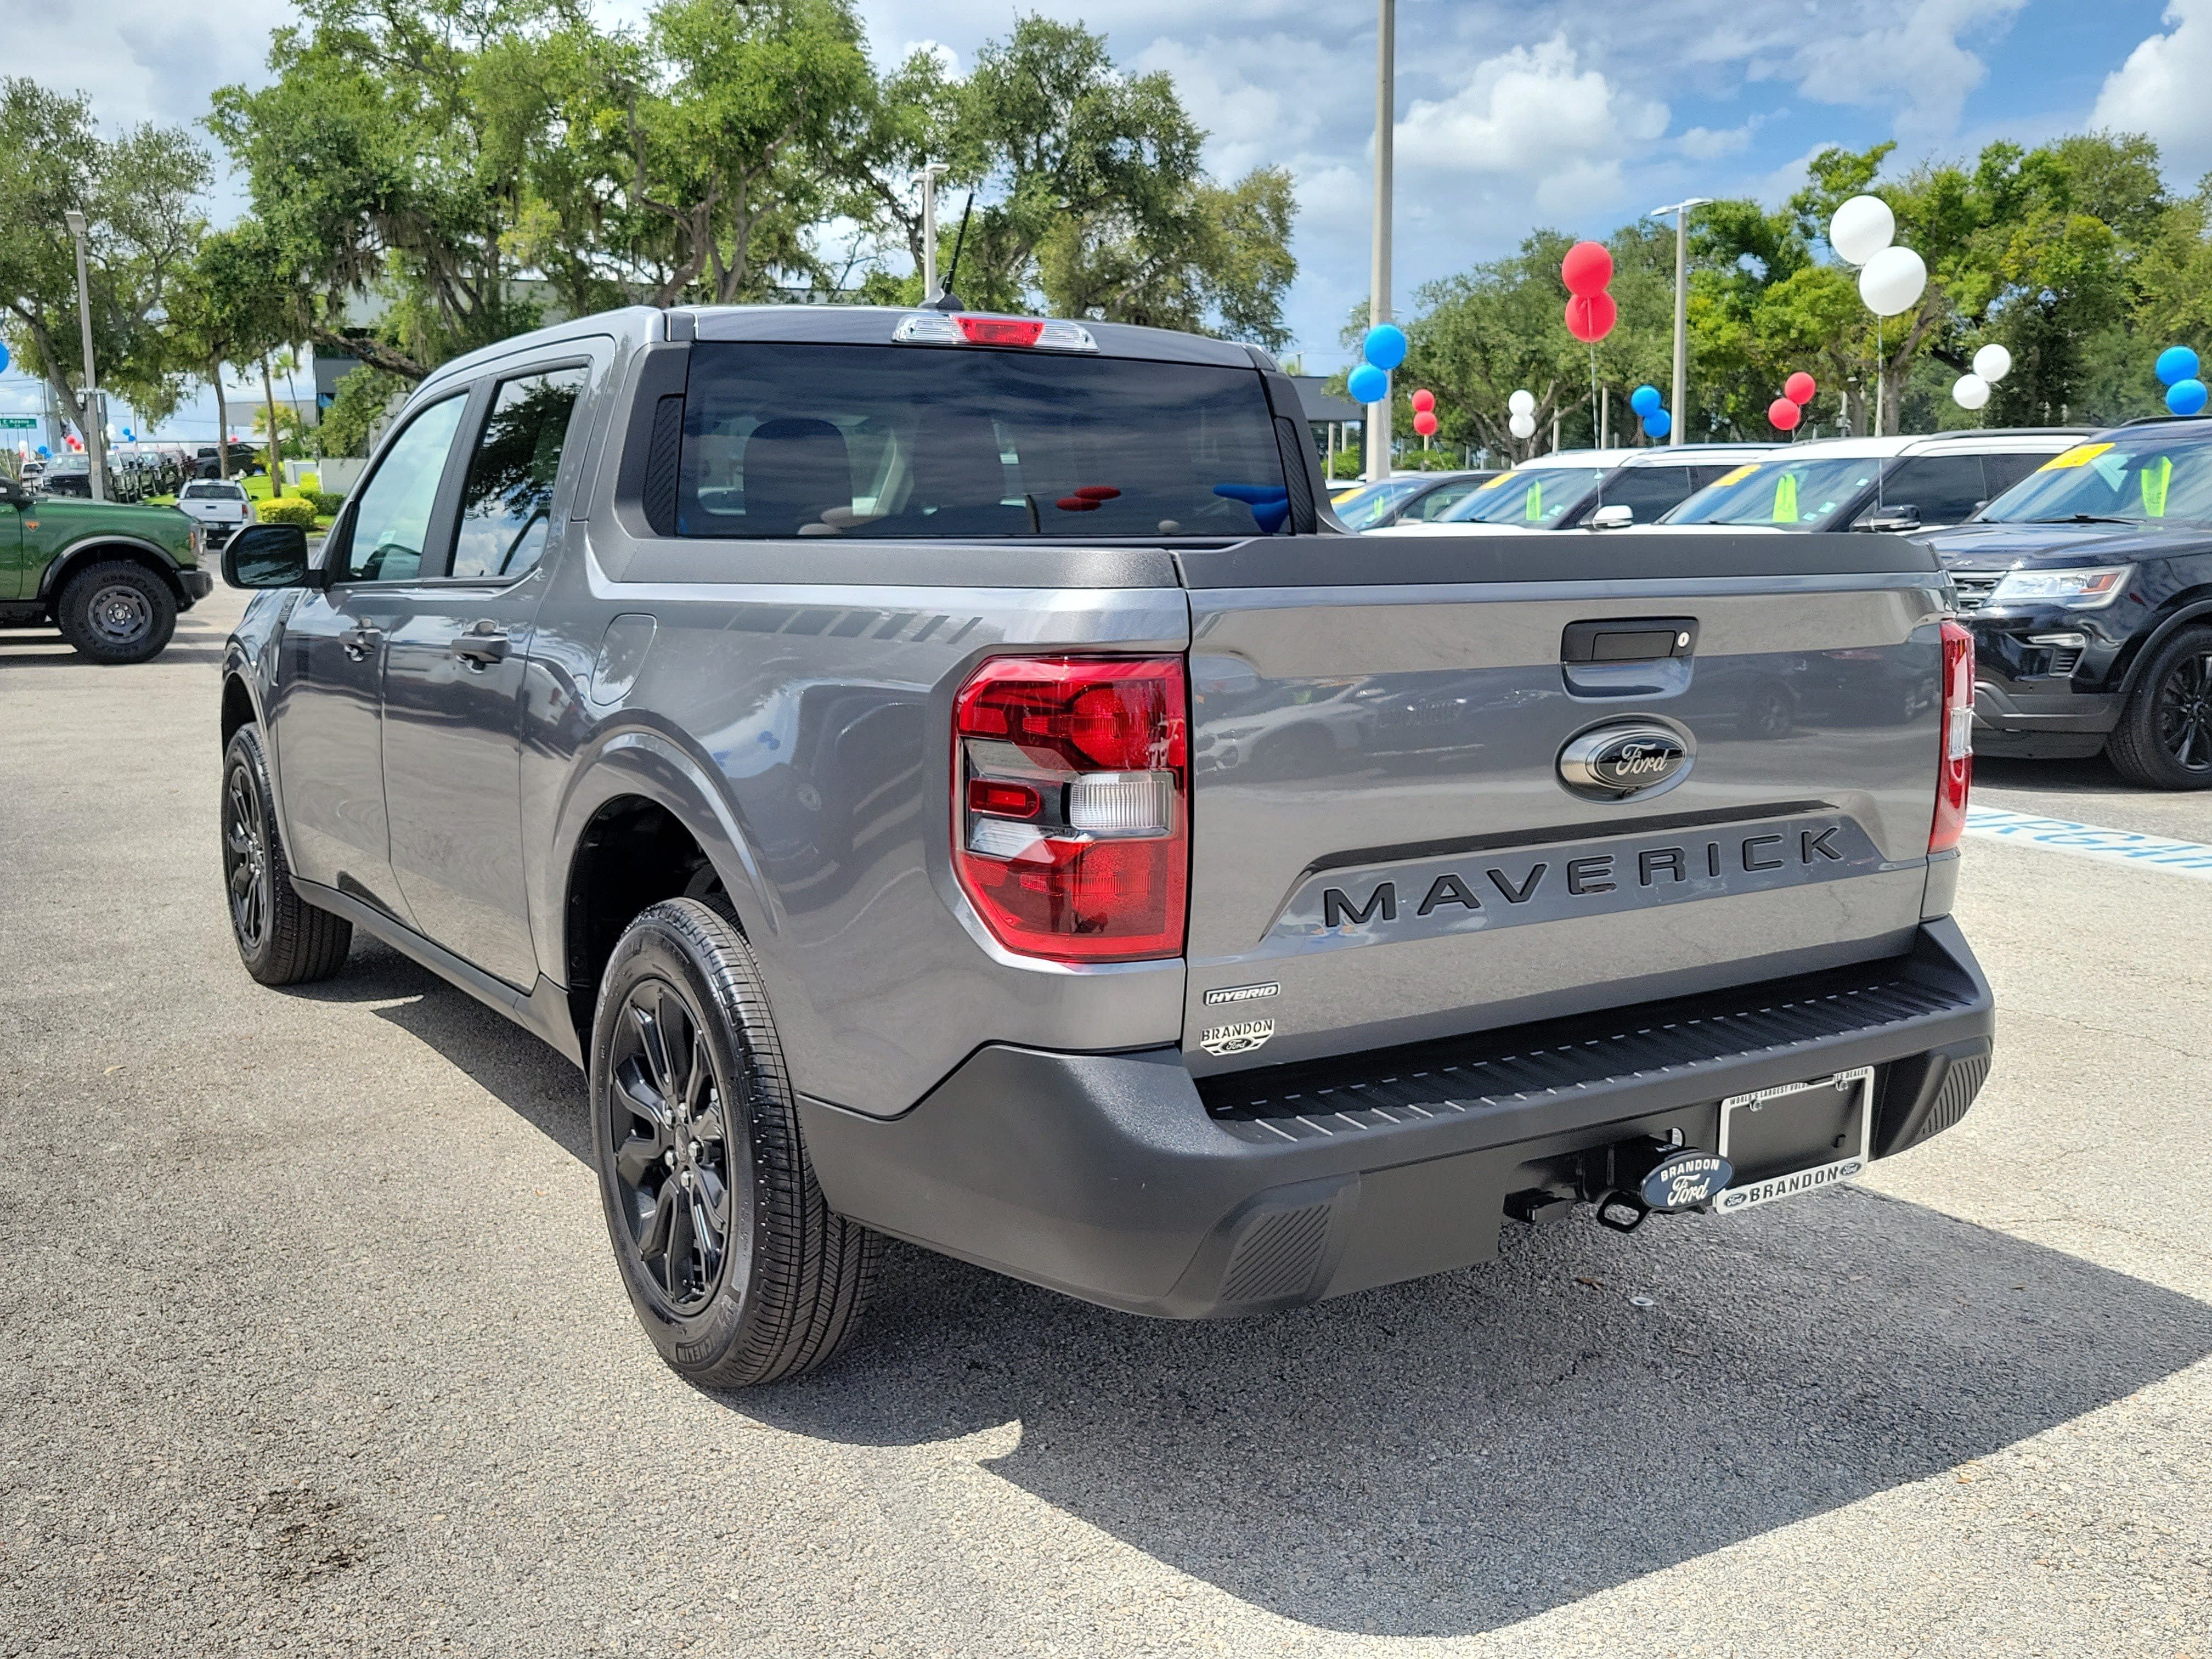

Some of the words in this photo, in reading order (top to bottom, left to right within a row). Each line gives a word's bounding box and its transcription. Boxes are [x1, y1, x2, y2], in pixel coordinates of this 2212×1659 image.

[1616, 743, 1669, 775] Ford
[1323, 827, 1843, 928] MAVERICK
[1210, 986, 1277, 1003] HYBRID
[1201, 1020, 1272, 1041] BRANDON
[1226, 1040, 1247, 1049] Ford
[1730, 1092, 1758, 1105] WORLD'S
[1760, 1086, 1787, 1097] LARGEST
[1790, 1082, 1809, 1091] VOLU
[1846, 1068, 1868, 1079] DEALER
[1661, 1159, 1720, 1182] BRANDON
[1726, 1194, 1745, 1206] Ford
[1750, 1166, 1838, 1202] BRANDON
[1842, 1163, 1860, 1175] Ford
[1667, 1173, 1711, 1206] Ford
